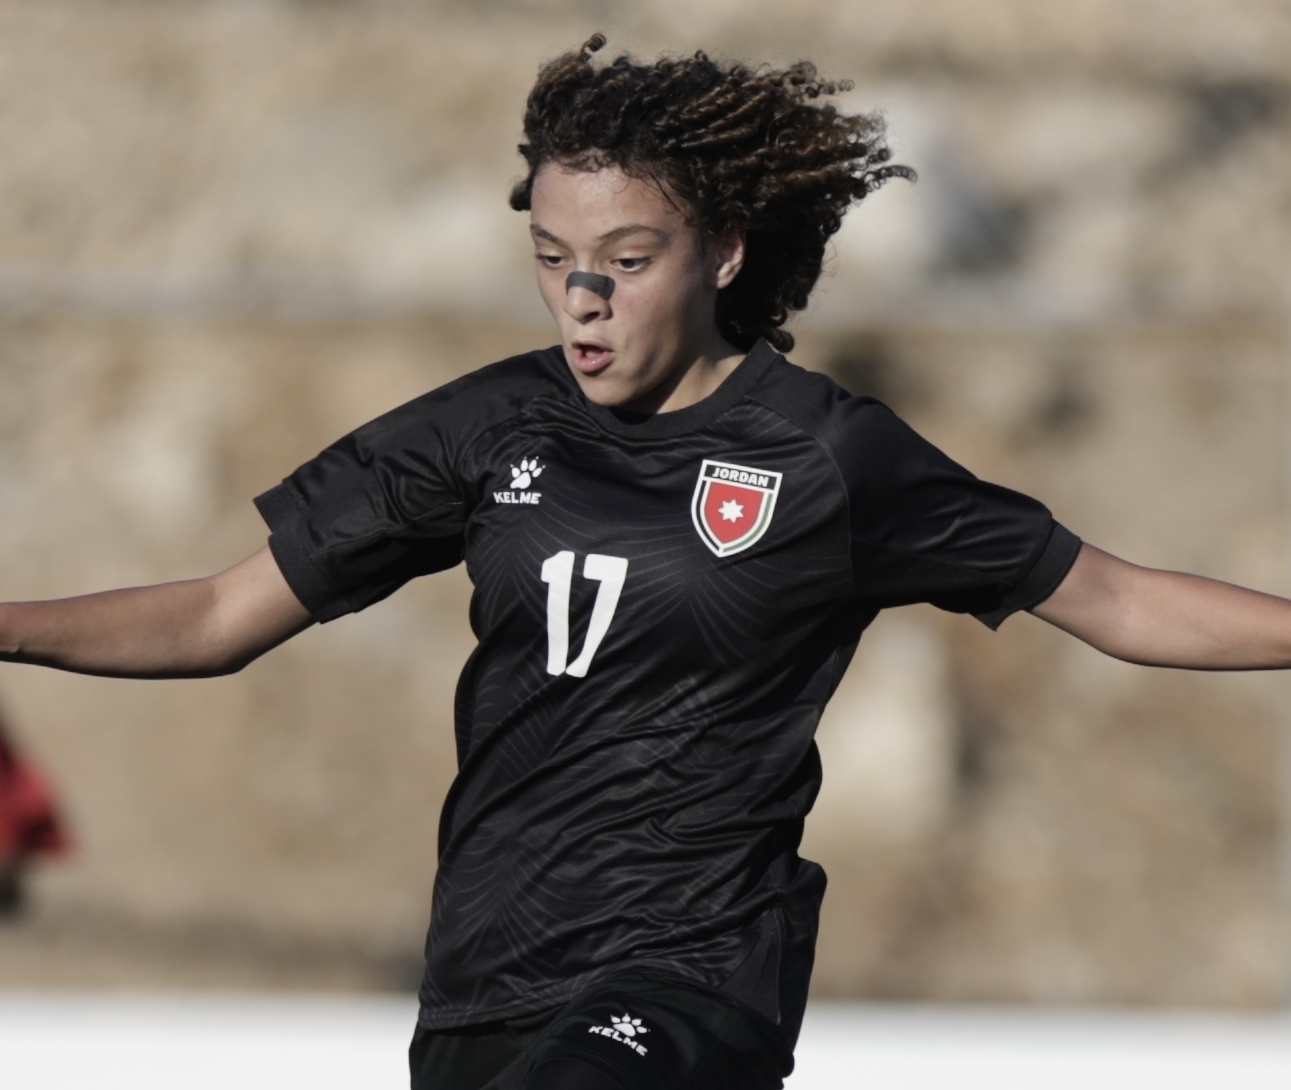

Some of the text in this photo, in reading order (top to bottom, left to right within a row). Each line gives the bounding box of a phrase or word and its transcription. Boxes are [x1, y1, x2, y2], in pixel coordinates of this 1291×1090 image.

[712, 467, 769, 487] JORDAN
[493, 491, 541, 504] KELME
[540, 550, 629, 678] 17
[589, 1026, 648, 1056] KELME
